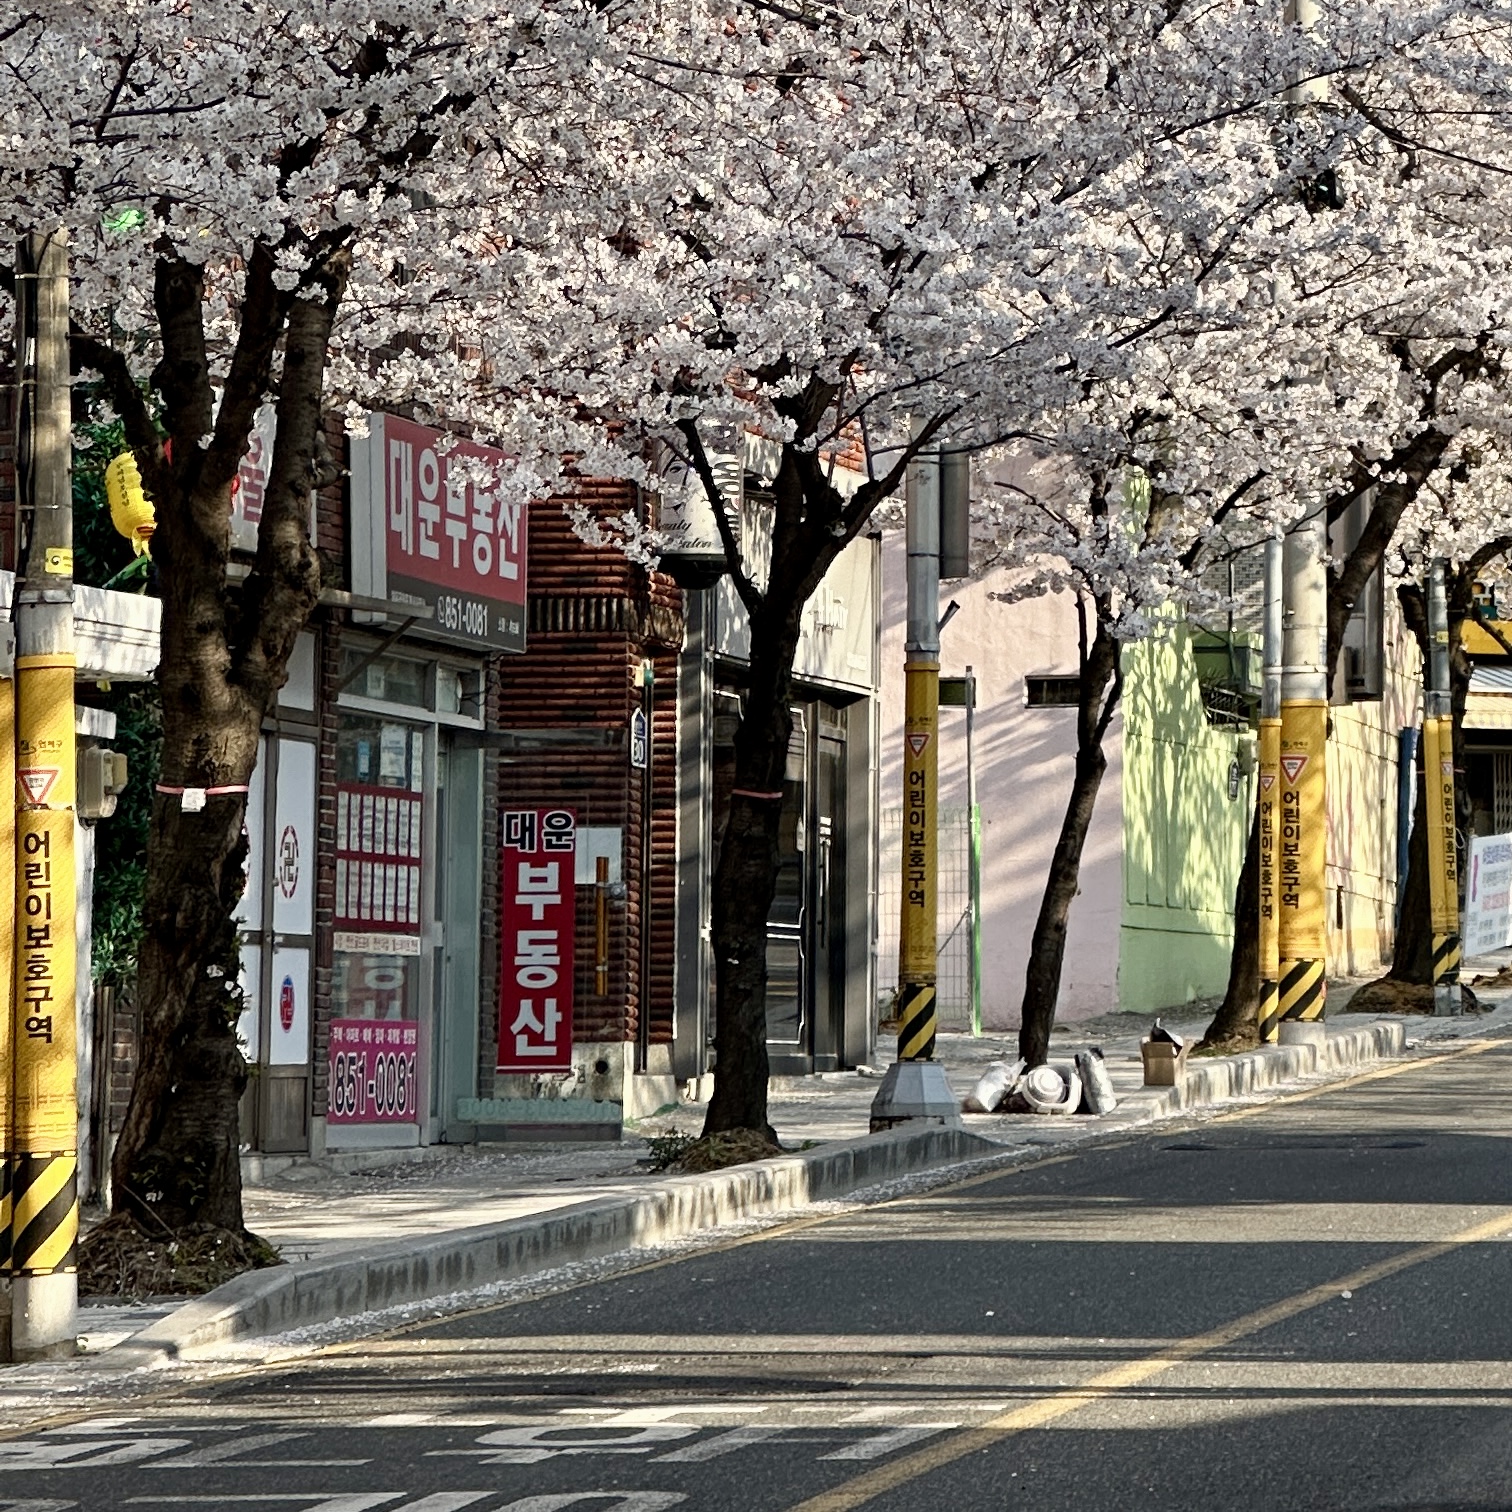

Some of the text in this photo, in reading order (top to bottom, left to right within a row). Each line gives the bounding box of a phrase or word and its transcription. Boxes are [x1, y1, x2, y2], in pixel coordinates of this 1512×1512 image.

[389, 438, 520, 580] 대운부동산
[445, 595, 488, 637] 851-0081
[633, 739, 644, 761] 30
[504, 810, 576, 853] 대운
[908, 769, 926, 908] 어린이보호구역
[1261, 801, 1273, 921] 어린이보호구역
[1282, 791, 1301, 909] 어린이보호구역
[24, 830, 53, 1044] 어린이보호구역
[510, 862, 562, 1058] 부동산
[334, 1051, 417, 1116] 851-0081
